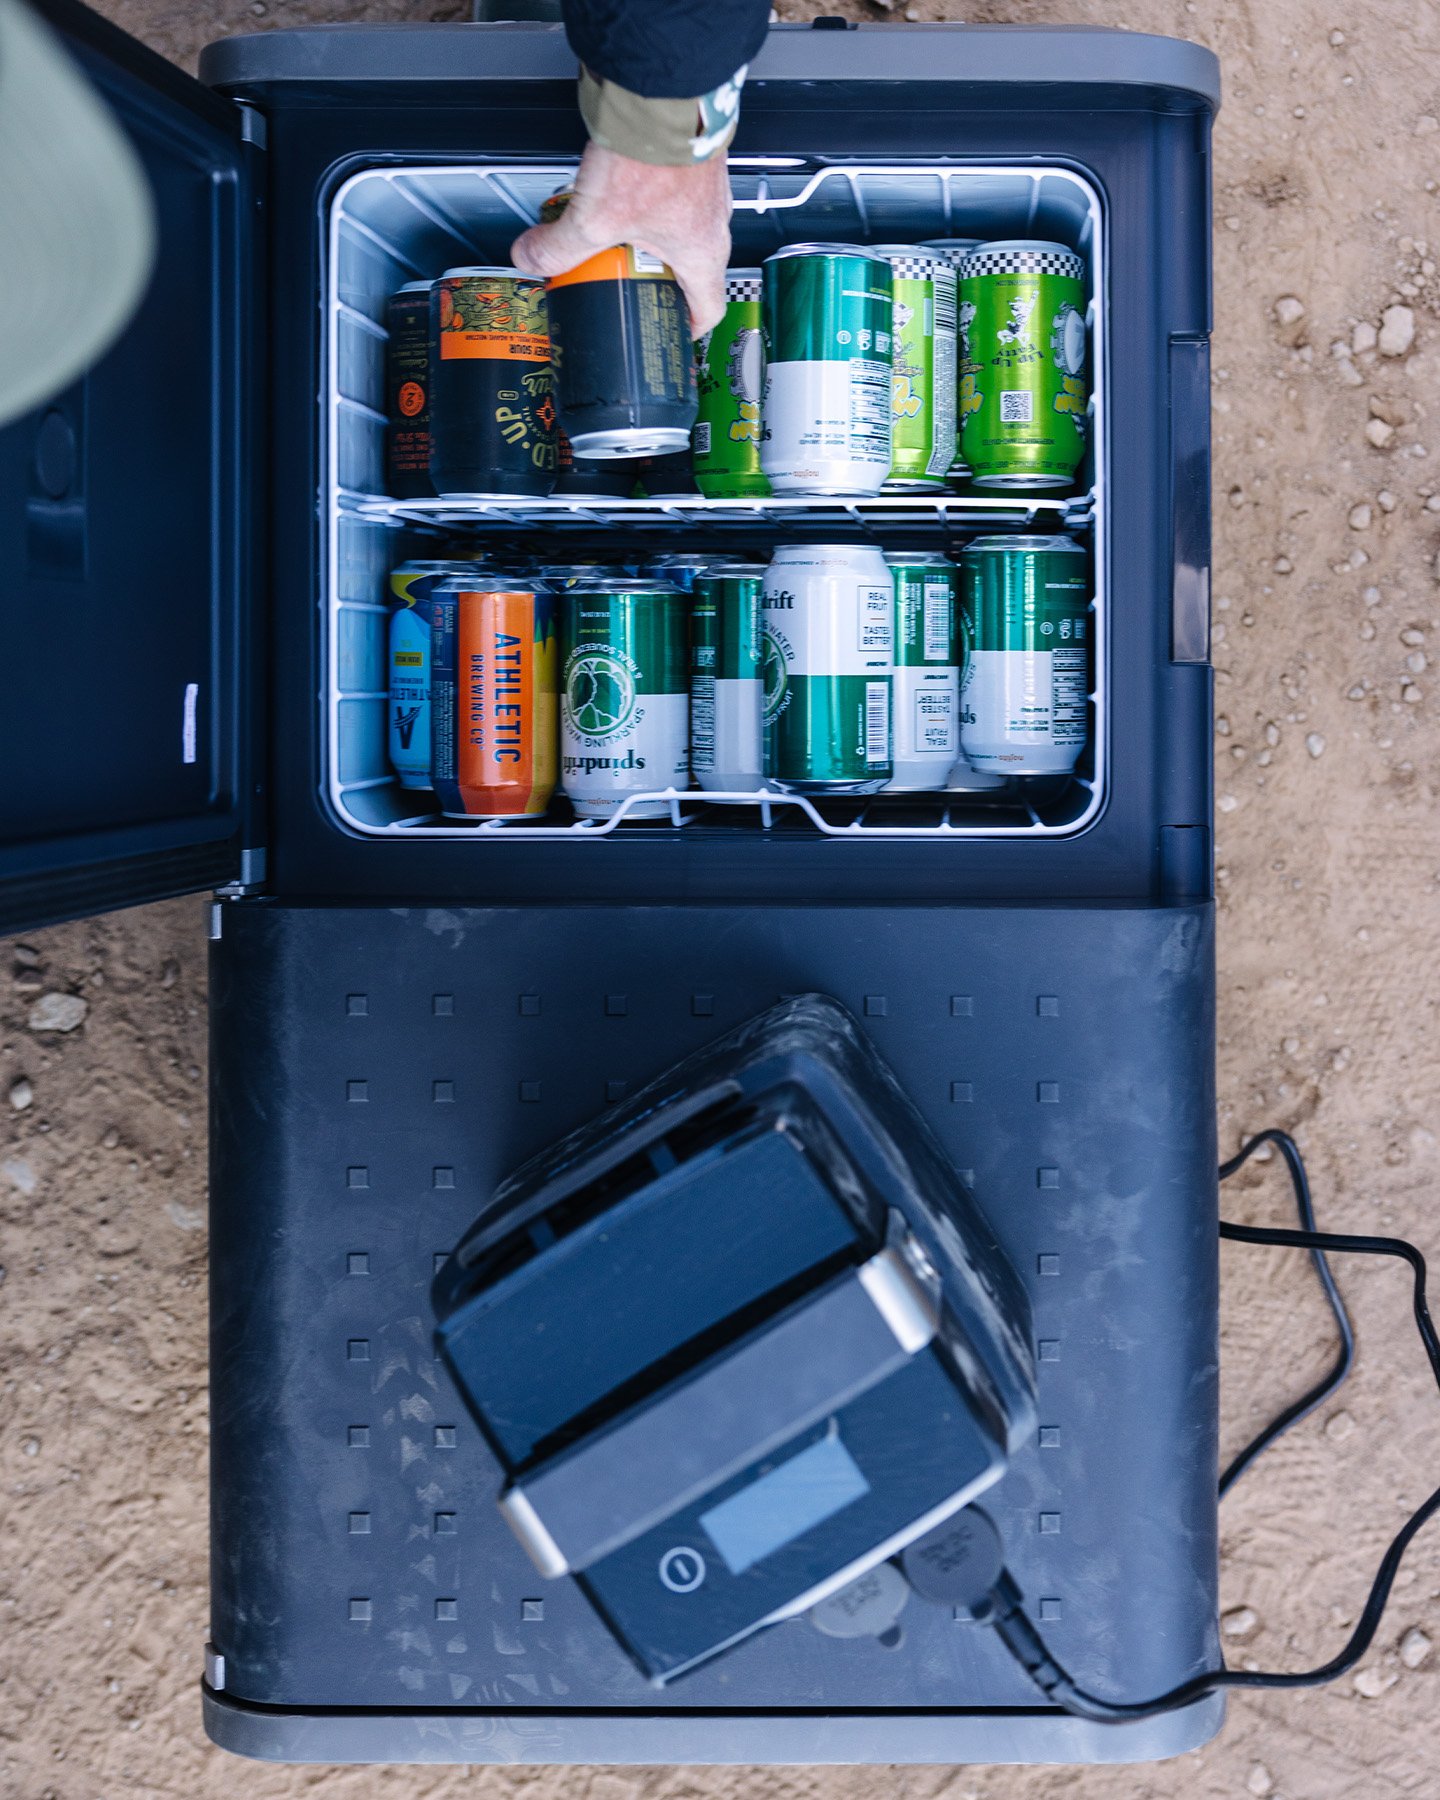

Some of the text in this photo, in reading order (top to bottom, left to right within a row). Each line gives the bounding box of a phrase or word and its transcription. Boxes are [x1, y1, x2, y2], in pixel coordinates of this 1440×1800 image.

[508, 344, 532, 356] SOUR
[991, 351, 1045, 367] Lip Up
[470, 654, 485, 722] BREWING
[493, 632, 522, 763] ATHLETIC
[583, 707, 645, 748] SPARKLING
[925, 728, 948, 737] FRUIT
[926, 738, 948, 746] REAL
